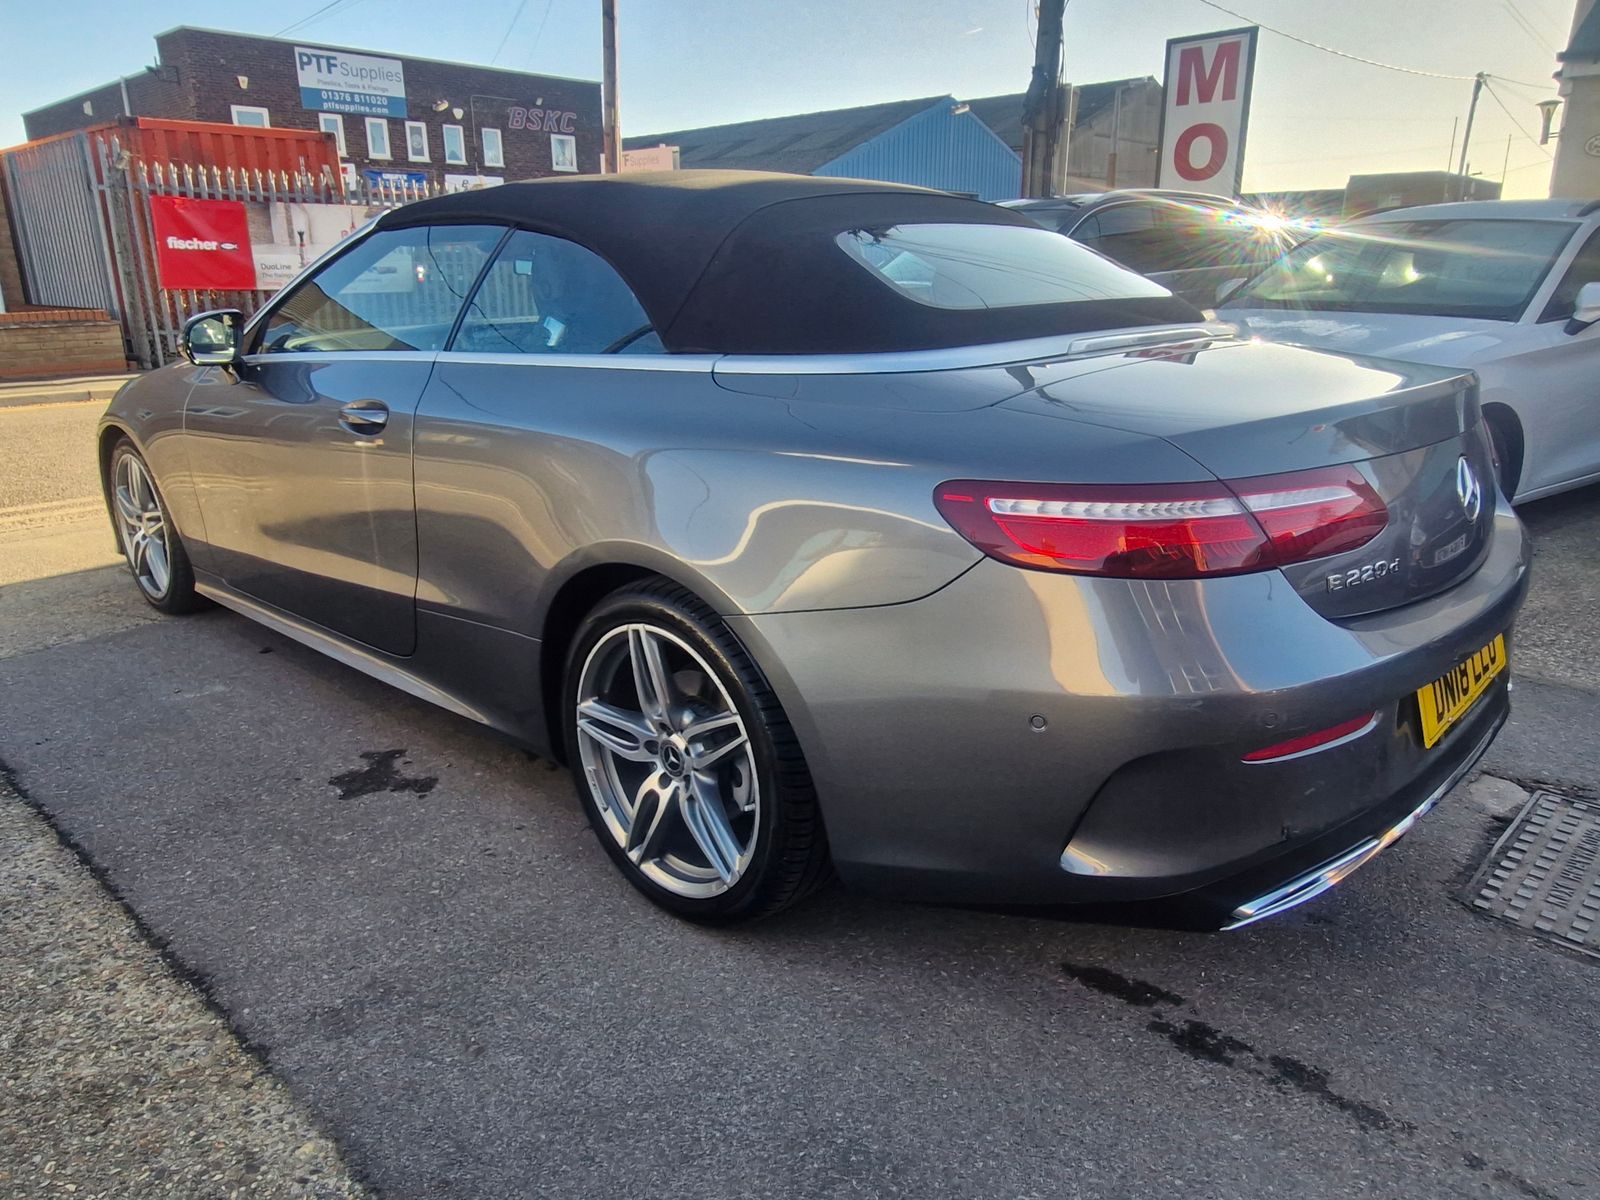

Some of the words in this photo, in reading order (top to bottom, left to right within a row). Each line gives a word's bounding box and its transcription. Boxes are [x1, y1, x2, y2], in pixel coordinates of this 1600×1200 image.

[298, 52, 338, 74] PTF
[340, 62, 402, 82] Supplies
[321, 90, 351, 102] 01376
[354, 93, 388, 106] 811020
[323, 102, 389, 114] ptfsupplies.com
[508, 106, 577, 133] BSKC
[167, 236, 218, 250] fischer
